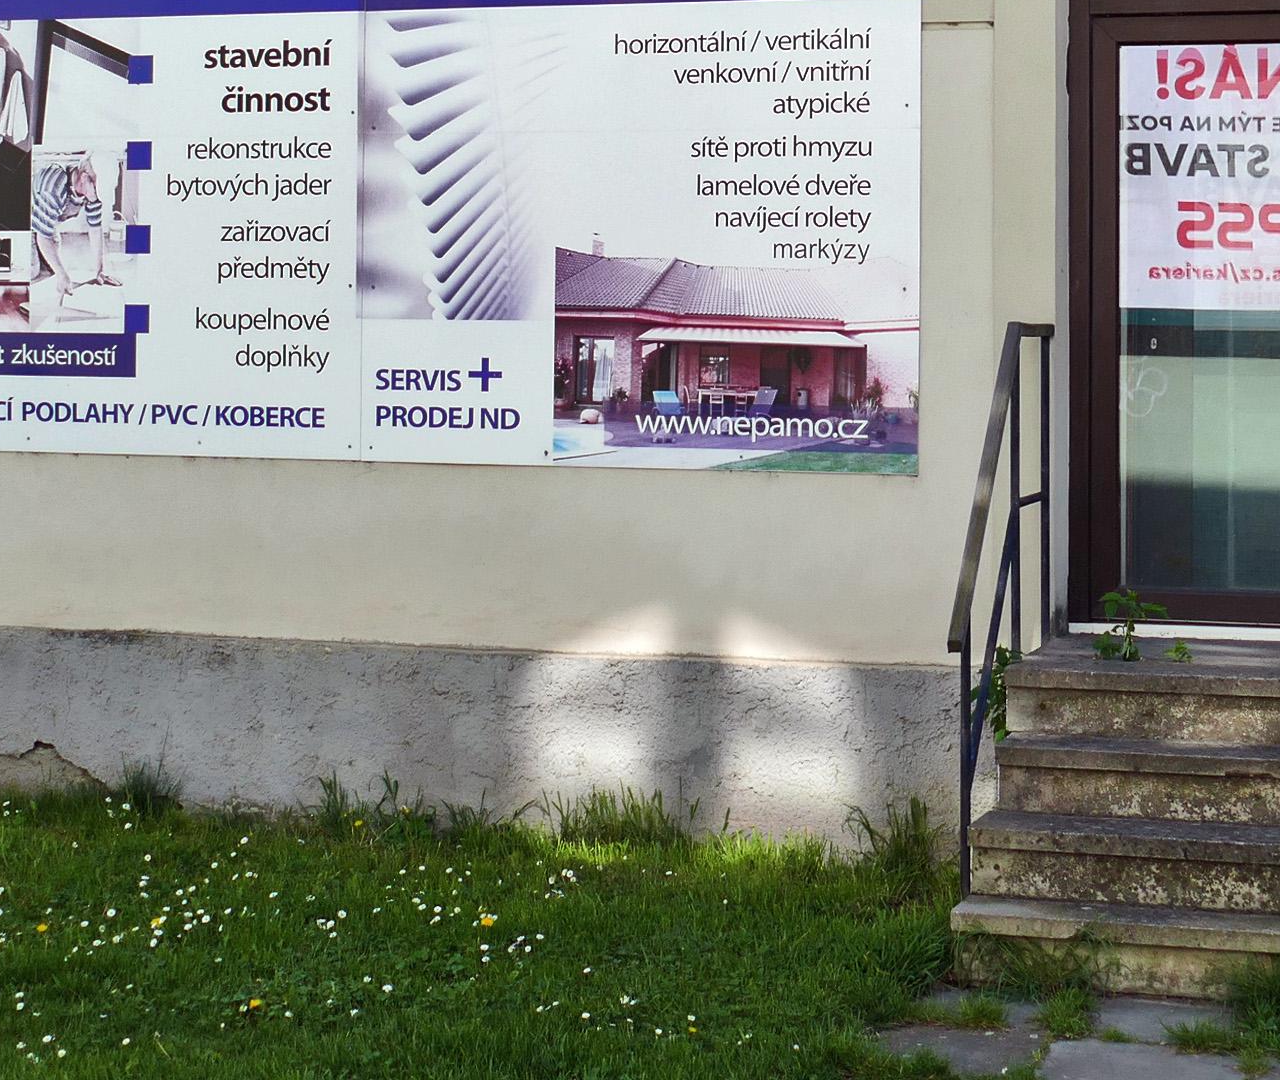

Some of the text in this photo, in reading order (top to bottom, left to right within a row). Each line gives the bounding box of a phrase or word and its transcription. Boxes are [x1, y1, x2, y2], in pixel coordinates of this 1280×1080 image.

[204, 39, 332, 69] stavební
[615, 27, 872, 55] horizontální / vertikální
[674, 59, 872, 84] venkovní / vnitřní
[221, 86, 331, 113] činnost
[773, 91, 871, 119] atypické
[187, 136, 332, 160] rekonstrukce
[691, 135, 872, 162] sítě proti hmyzu
[167, 172, 332, 202] bytových jader
[696, 174, 871, 196] lamelové dveře
[221, 220, 331, 242] zařizovací
[715, 206, 872, 233] navíjecí rolety
[773, 238, 870, 265] markýzy
[217, 256, 330, 284] předměty
[195, 307, 330, 336] koupelnové
[11, 344, 117, 367] zkušeností
[235, 345, 330, 373] doplňky
[375, 357, 503, 392] SERVIS +
[22, 402, 134, 424] PODLAHY
[138, 403, 148, 425] /
[151, 404, 198, 426] PVC
[202, 405, 212, 427] /
[215, 406, 325, 429] KOBERCE
[375, 405, 520, 430] PRODEJ ND
[635, 412, 868, 442] www.nepamo.cz
